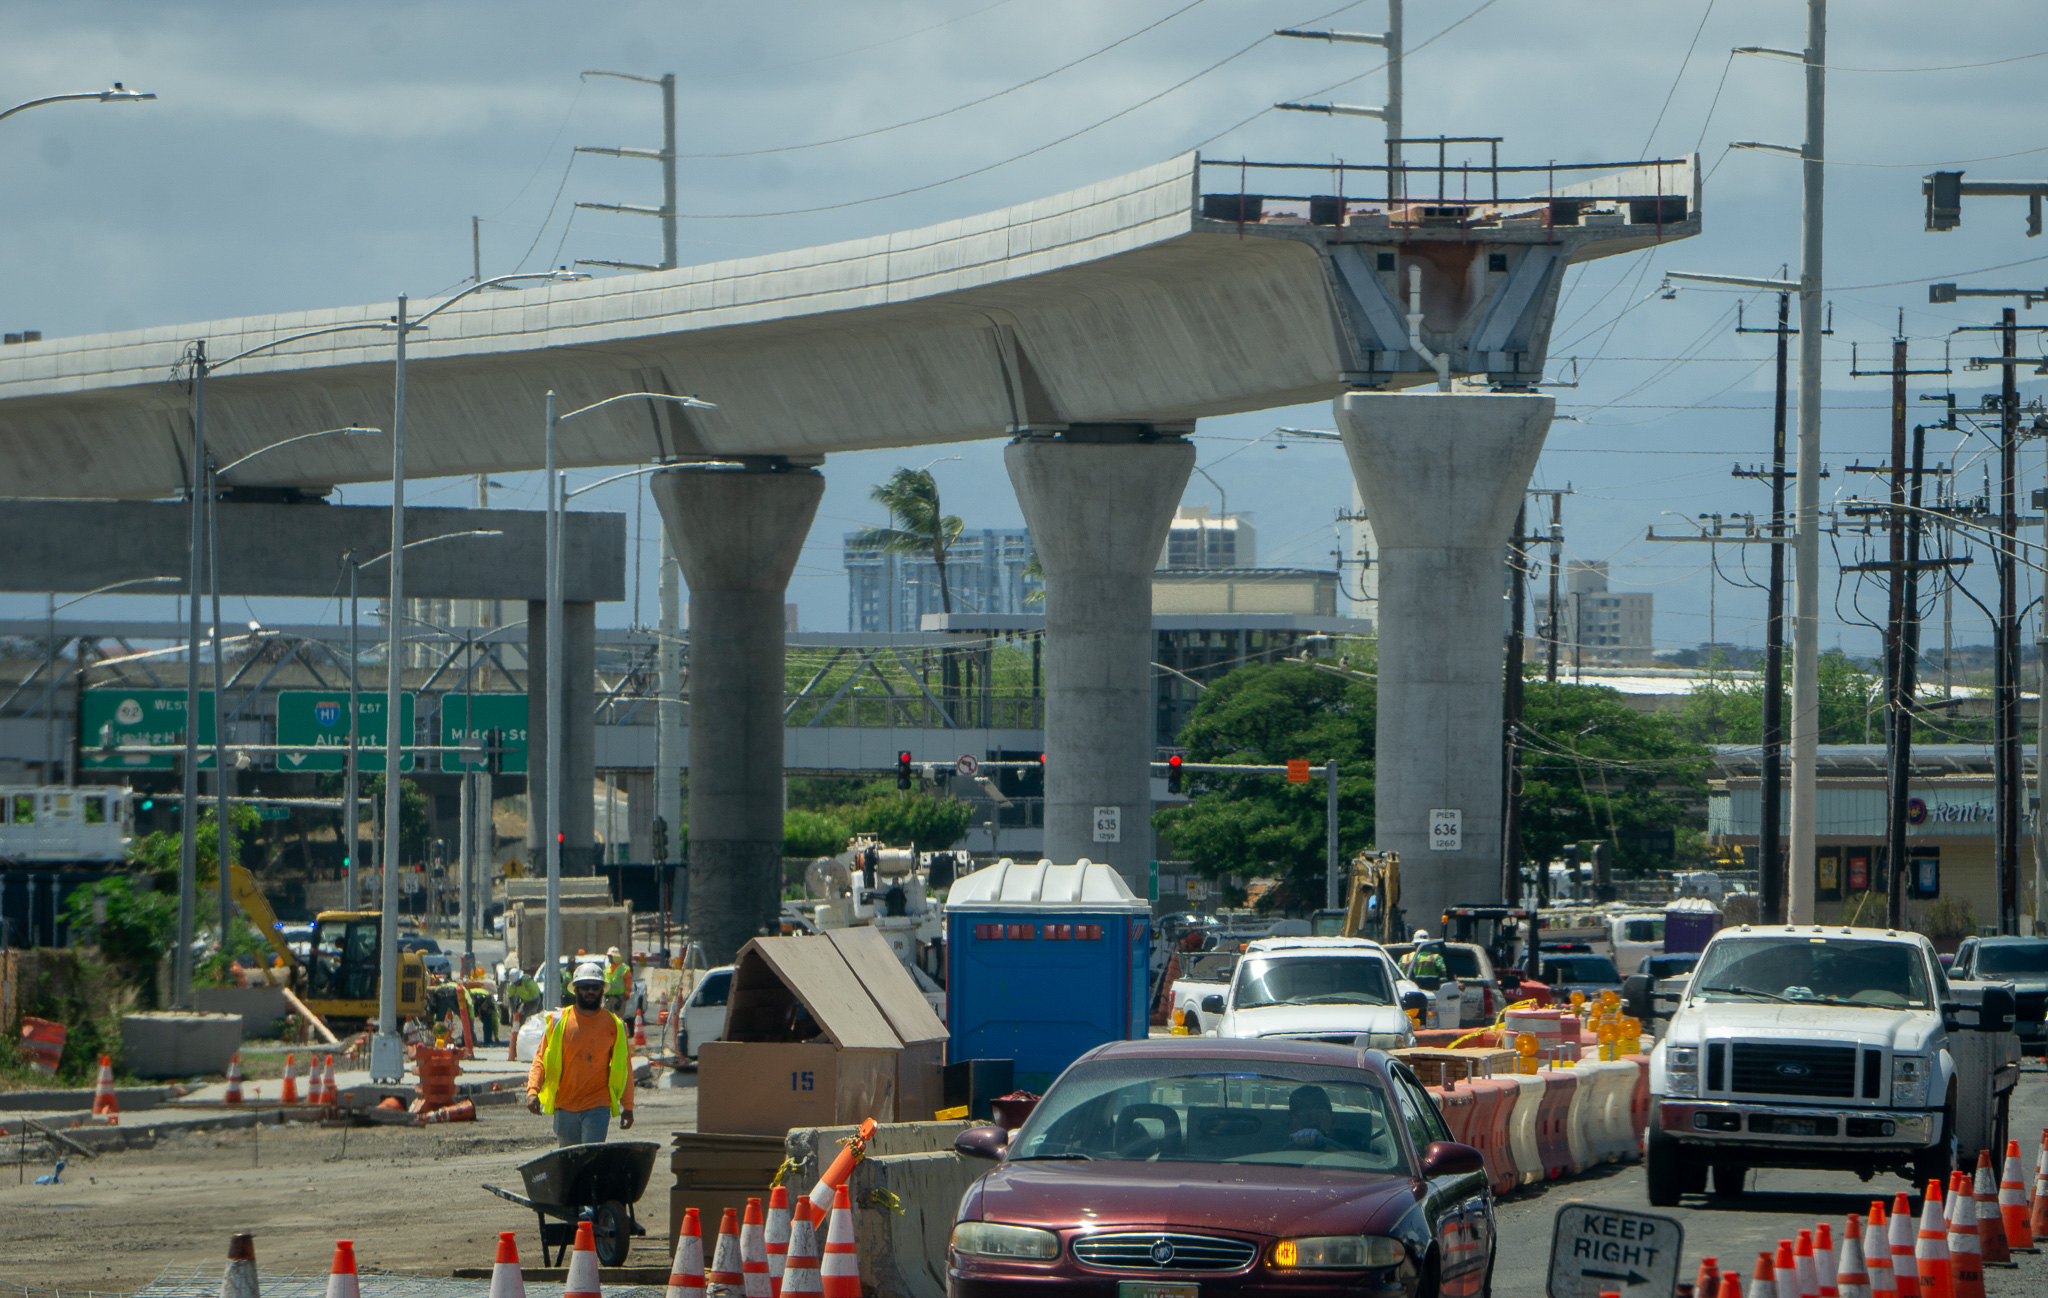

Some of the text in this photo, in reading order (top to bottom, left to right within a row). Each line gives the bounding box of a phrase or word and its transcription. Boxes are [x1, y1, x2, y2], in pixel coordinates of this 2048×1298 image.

[315, 734, 377, 747] Airrt
[509, 729, 527, 741] St
[1097, 819, 1117, 830] 635
[1434, 824, 1457, 836] 636
[791, 1071, 814, 1091] 15
[1583, 1213, 1656, 1241] KEEP
[1573, 1237, 1660, 1268] RIGHT
